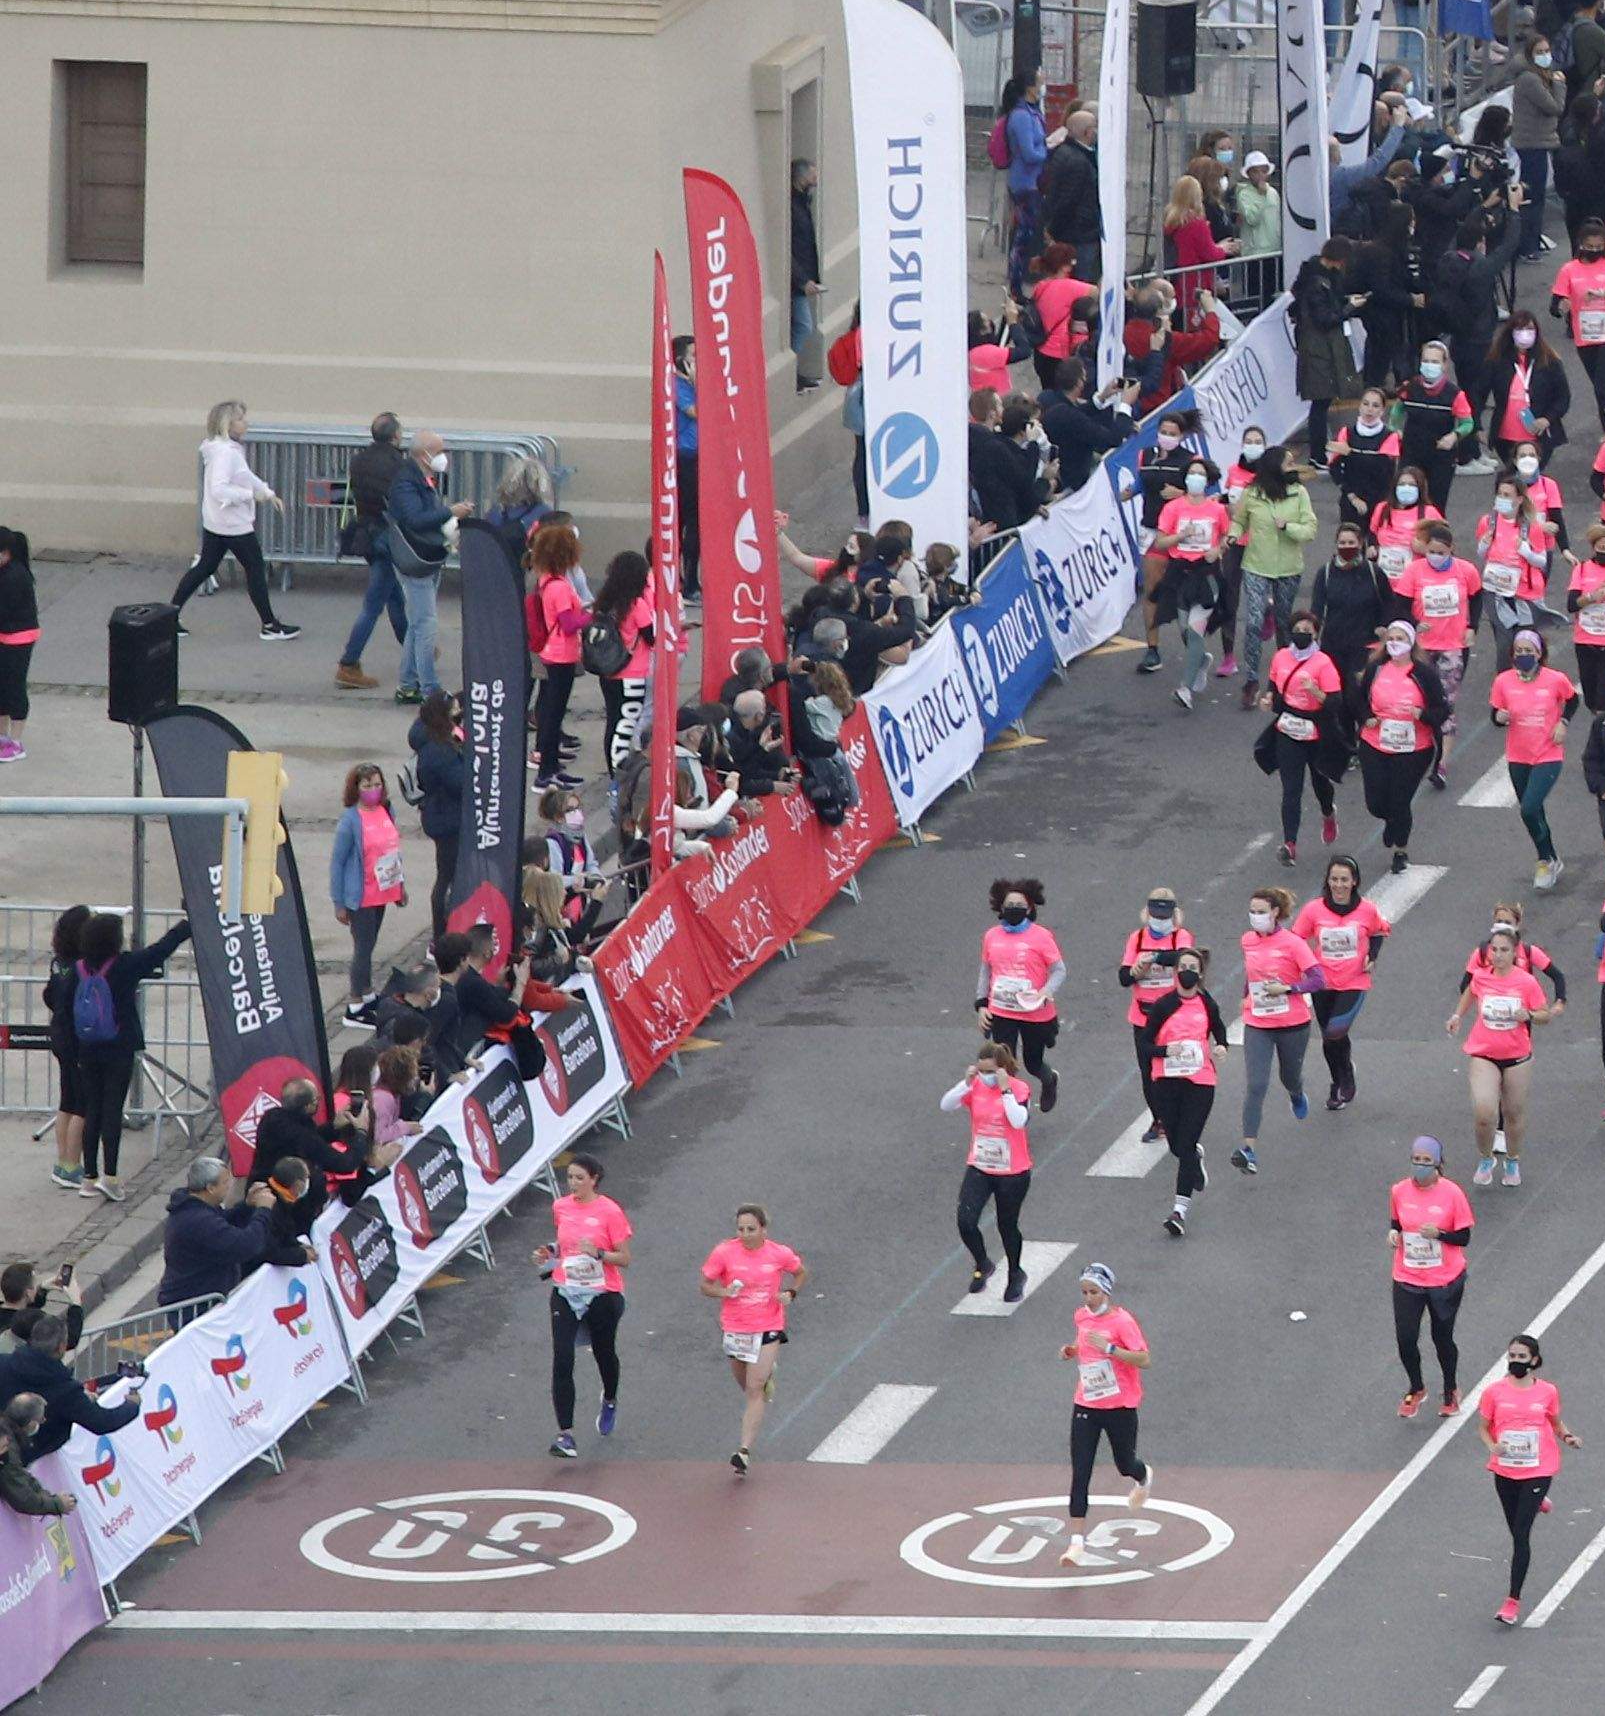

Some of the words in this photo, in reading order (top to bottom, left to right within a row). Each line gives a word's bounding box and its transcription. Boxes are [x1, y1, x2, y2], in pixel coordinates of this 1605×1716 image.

[1063, 528, 1127, 609] ZURICH
[987, 590, 1043, 684] ZURICH
[901, 671, 972, 765] ZURICH
[563, 1034, 598, 1076] Barcelona
[492, 1103, 528, 1145] Barcelona
[424, 1169, 459, 1212] Barcelona
